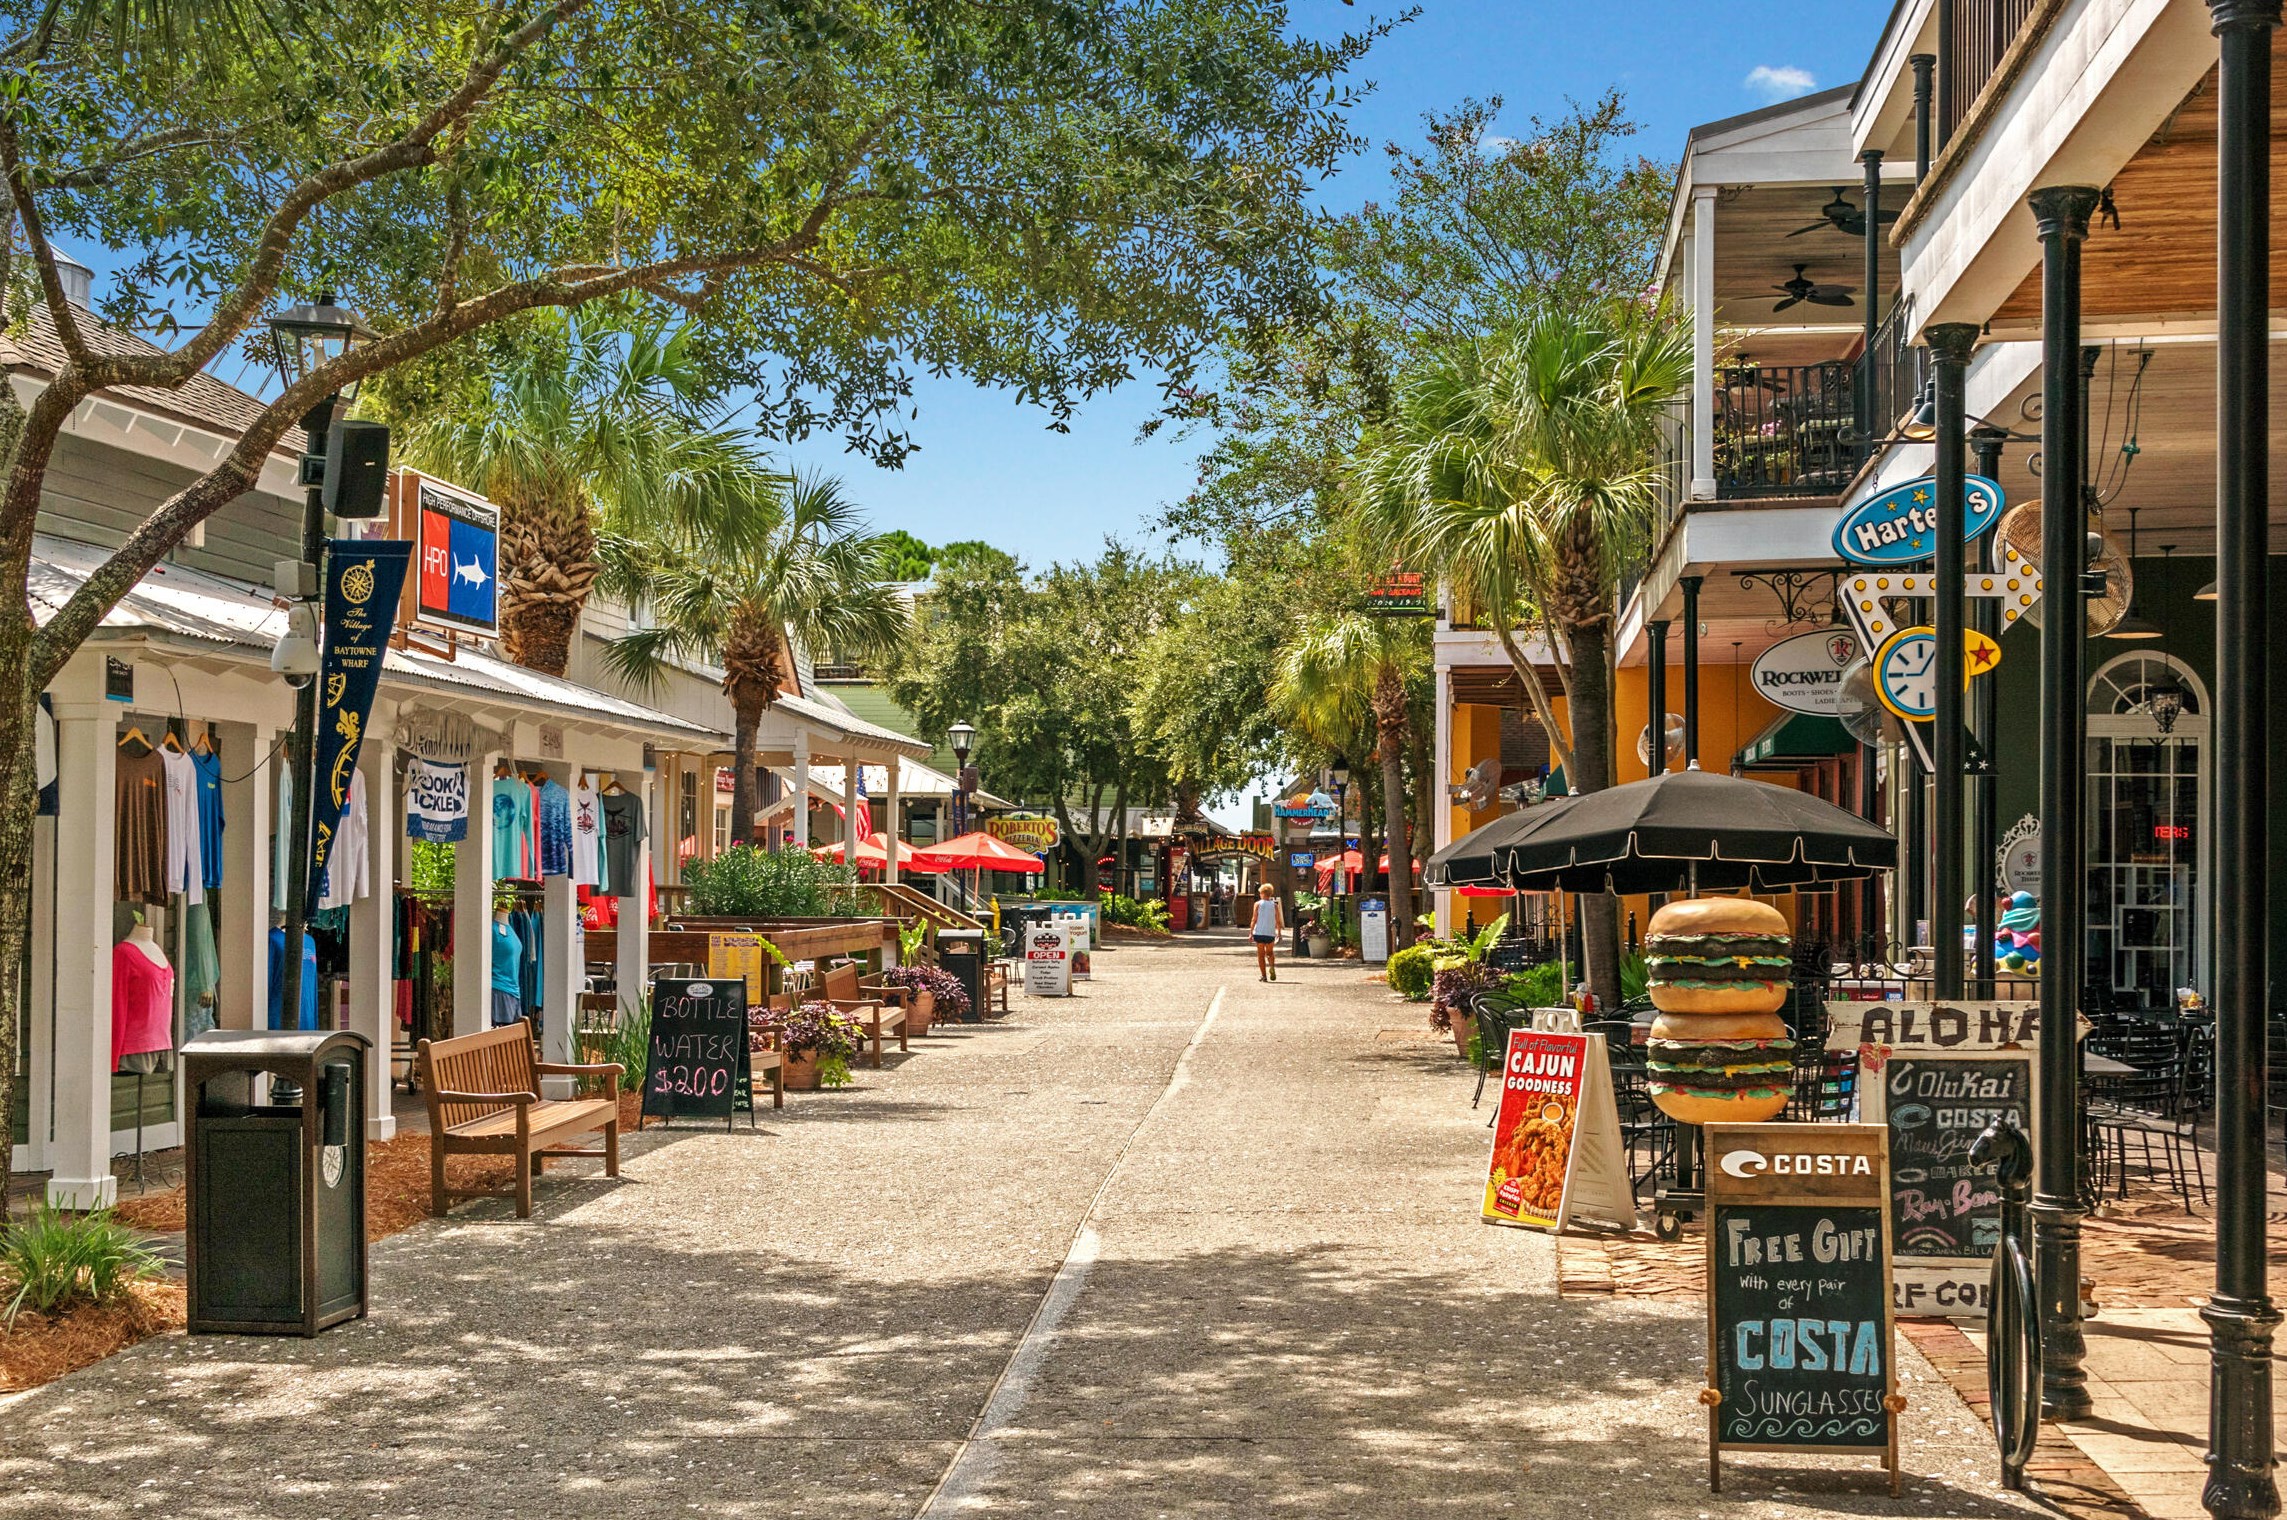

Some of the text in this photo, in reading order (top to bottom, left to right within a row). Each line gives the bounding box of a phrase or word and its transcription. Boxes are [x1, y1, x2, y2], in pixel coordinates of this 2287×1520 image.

[423, 493, 496, 528] HIGH PERFORMANCE OFFSHORE
[424, 544, 448, 578] HPO
[346, 607, 367, 617] The
[341, 619, 373, 632] Village
[350, 632, 362, 644] of
[334, 646, 377, 656] BAYTOWNE
[341, 659, 369, 668] WHARF
[1761, 670, 1842, 687] ROCKWEL
[1237, 835, 1275, 862] DOOR
[1033, 951, 1060, 959] OPEN
[660, 995, 739, 1020] BOTTLE
[655, 1033, 735, 1062] WATER
[1512, 1036, 1579, 1054] Full of Flavorful
[1510, 1051, 1576, 1078] CAJUN
[1507, 1076, 1573, 1096] GOODNESS
[1917, 1071, 2015, 1099] OluKai
[1936, 1108, 2022, 1129] COSTA
[1774, 1155, 1871, 1175] COSTA
[1930, 1165, 2000, 1180] OAKLE
[1727, 1218, 1876, 1267] FREE GIFT
[1963, 1245, 1993, 1257] BILLA
[1777, 1279, 1812, 1302] every
[1778, 1296, 1794, 1310] of
[1736, 1318, 1880, 1376] COSTA
[1735, 1380, 1884, 1417] SUNGLASSES
